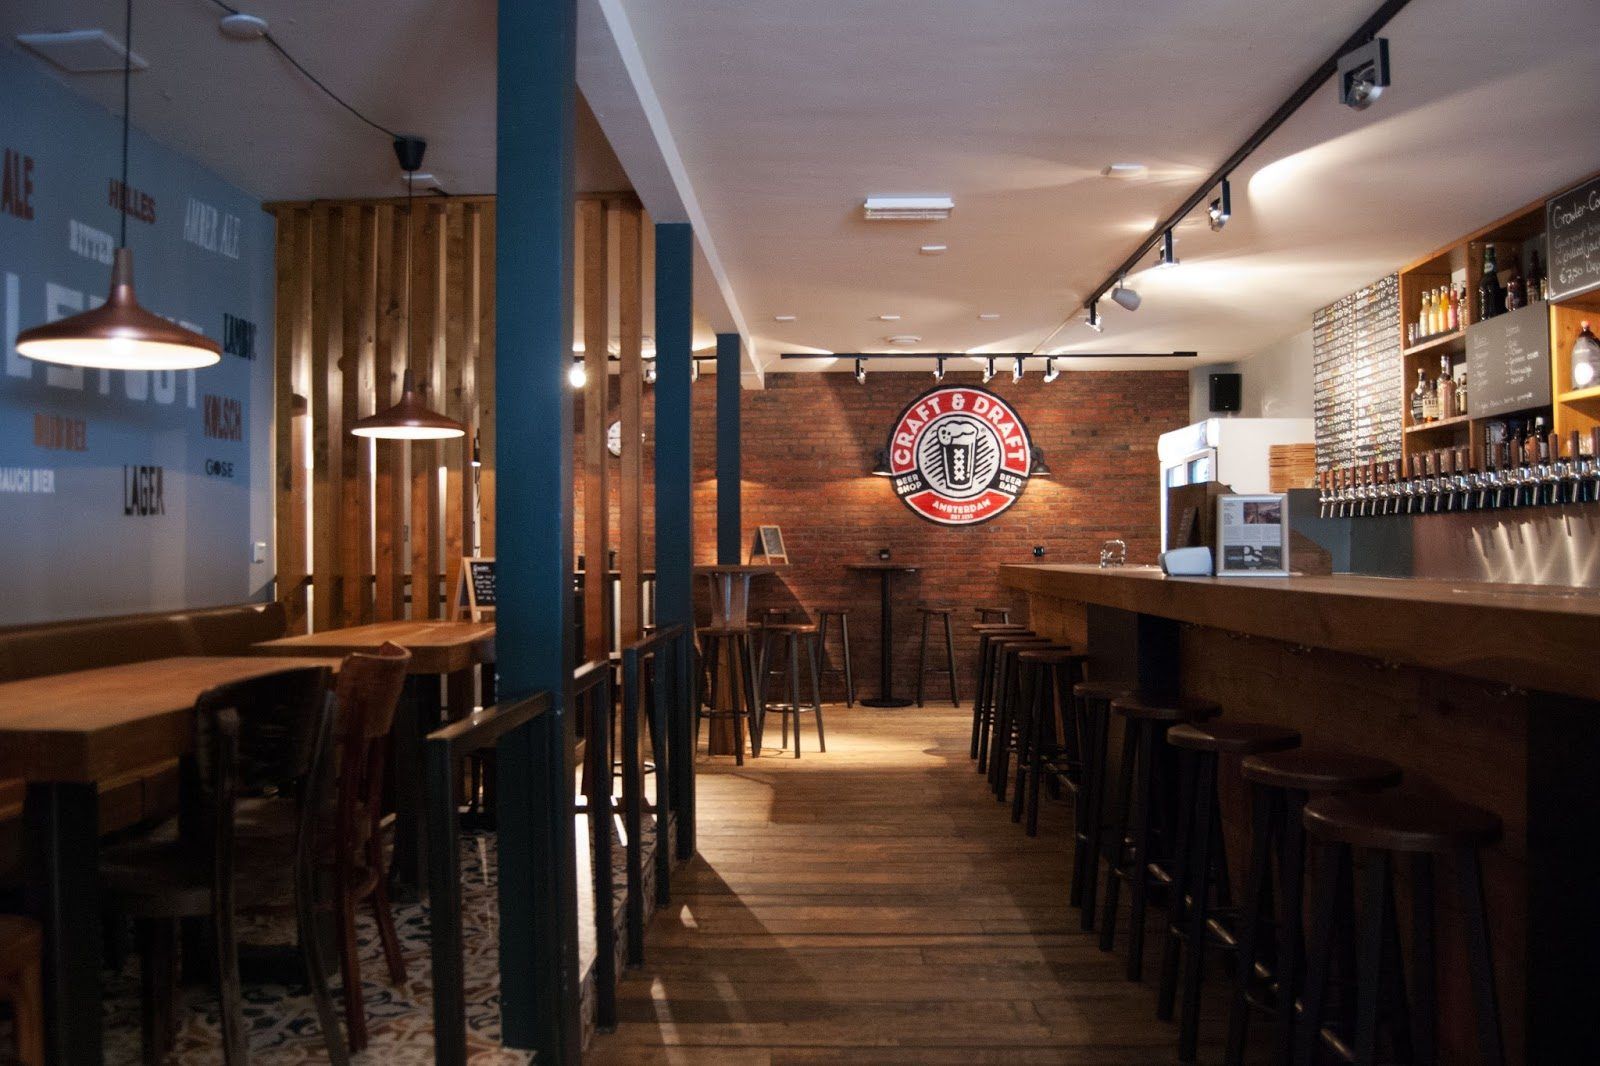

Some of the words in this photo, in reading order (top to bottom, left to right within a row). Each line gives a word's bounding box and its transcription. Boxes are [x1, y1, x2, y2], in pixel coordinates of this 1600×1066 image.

[894, 396, 941, 465] CRAFT
[952, 393, 966, 410] &
[972, 396, 1025, 462] DRAFT
[0, 467, 30, 493] AUCH
[896, 474, 919, 487] BEER
[1000, 473, 1022, 487] BEER
[124, 465, 164, 516] LAGER
[897, 481, 922, 495] SHOP
[999, 481, 1018, 494] BAR
[932, 499, 991, 513] AMSTERDAM
